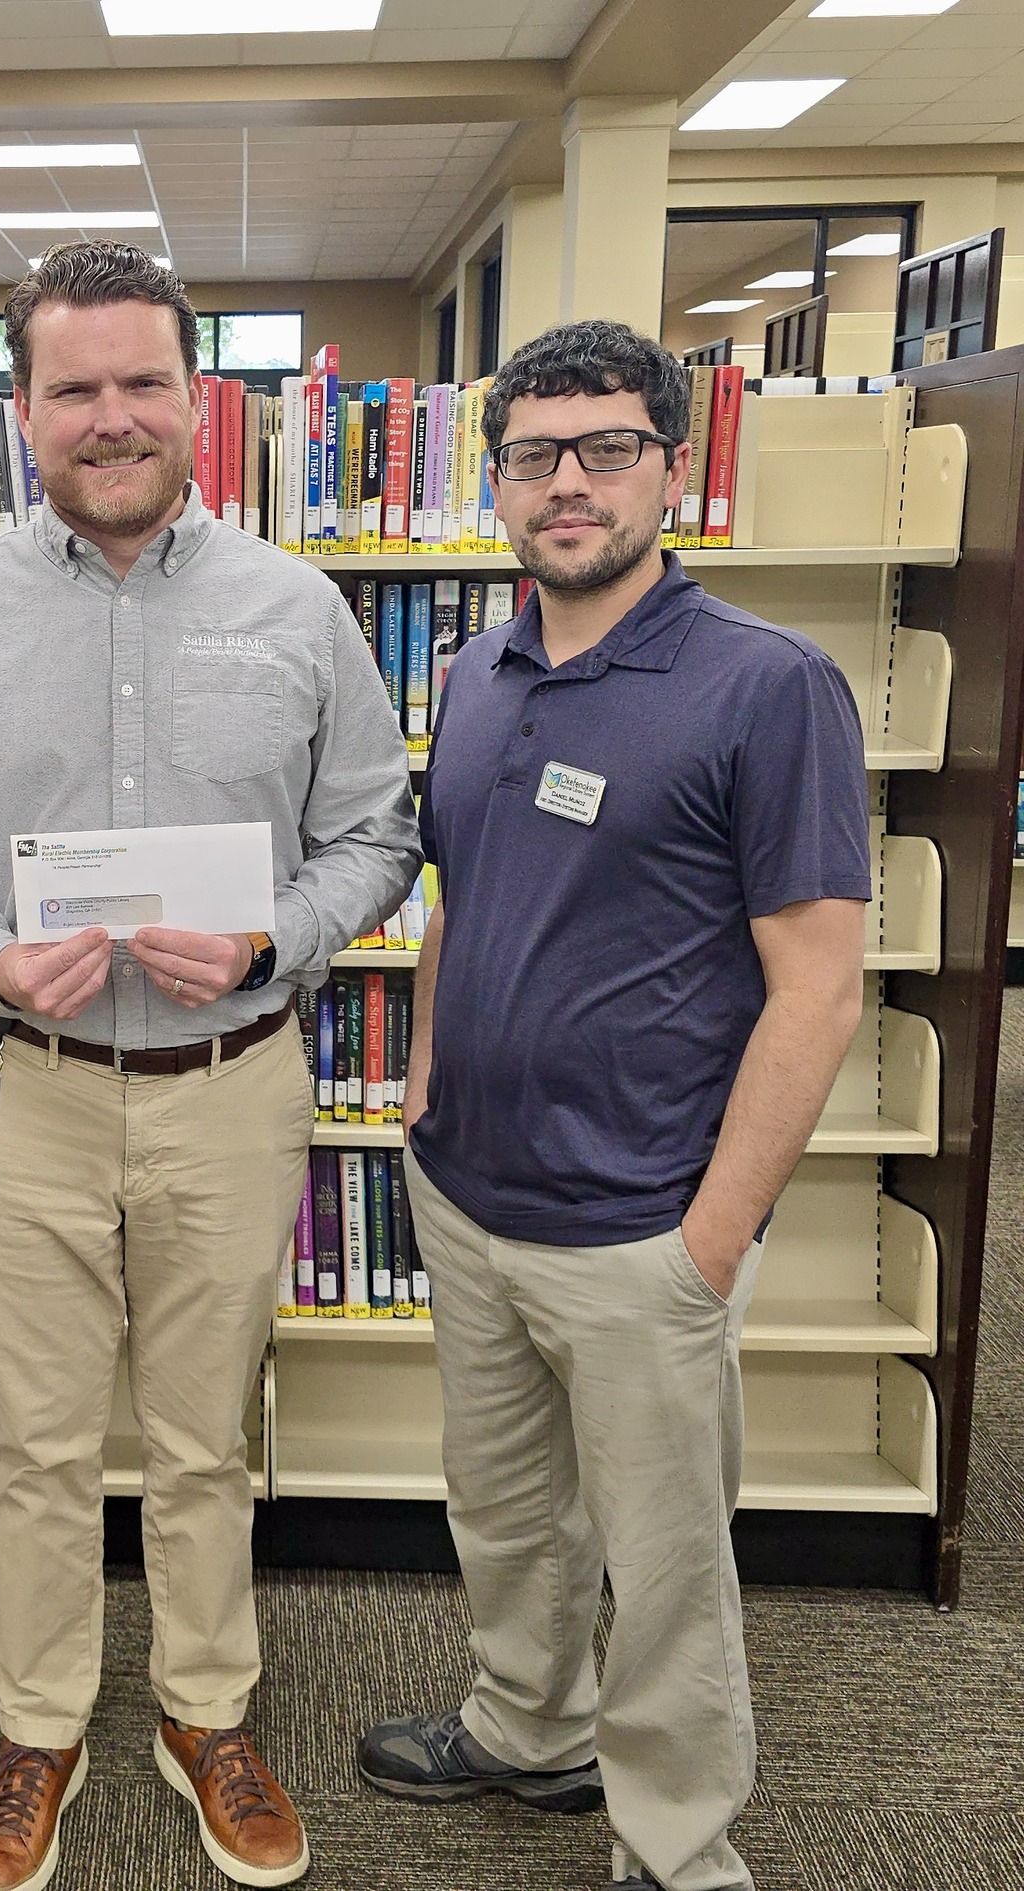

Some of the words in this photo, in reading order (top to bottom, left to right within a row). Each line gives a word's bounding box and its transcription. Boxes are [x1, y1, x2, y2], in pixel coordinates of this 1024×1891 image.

[202, 384, 211, 398] no
[695, 374, 706, 394] AL
[201, 399, 210, 426] more
[311, 391, 321, 412] CRASH
[328, 405, 336, 413] 5
[434, 391, 442, 420] Nature's
[448, 390, 456, 422] RAISING
[7, 415, 16, 431] The
[292, 422, 299, 431] of
[310, 413, 320, 433] COURSE
[327, 414, 337, 446] TEAS
[434, 421, 442, 445] Garden
[691, 401, 705, 457] PACINO
[721, 412, 733, 438] Tiger,
[202, 428, 211, 454] tears
[290, 432, 298, 442] my
[368, 428, 378, 452] Ham
[10, 454, 19, 469] Day
[228, 448, 235, 460] GO
[290, 443, 298, 466] mother
[309, 443, 319, 457] ATI
[350, 448, 360, 472] WE'RE
[720, 439, 730, 461] Tiger
[309, 458, 319, 478] TEAS
[327, 451, 335, 482] PRACTICE
[368, 453, 378, 479] Radio
[388, 460, 405, 468] thing
[446, 450, 454, 485] HUMANS
[719, 464, 727, 486] James
[29, 478, 39, 500] MIKE
[201, 463, 212, 499] gardiner
[289, 472, 297, 496] SHARI
[685, 462, 699, 494] Sonny
[350, 474, 360, 509] PREGNAN
[362, 584, 372, 608] OUR
[469, 589, 479, 633] PEOPLE
[363, 612, 372, 639] LAST
[183, 634, 223, 647] Satilla
[226, 636, 270, 650] REMC
[411, 642, 419, 669] RIVERS
[411, 670, 419, 696] MERGE
[561, 774, 597, 793] Okefenokee
[18, 842, 33, 854] EMC
[368, 984, 379, 1027] Two-Step
[350, 1035, 360, 1051] Love
[369, 1028, 379, 1050] Devil
[370, 1056, 378, 1078] Jamie
[348, 1161, 357, 1177] THE
[349, 1180, 358, 1203] VIEW
[374, 1179, 382, 1202] CLOSE
[350, 1221, 359, 1242] LAKE
[350, 1246, 360, 1271] COMO
